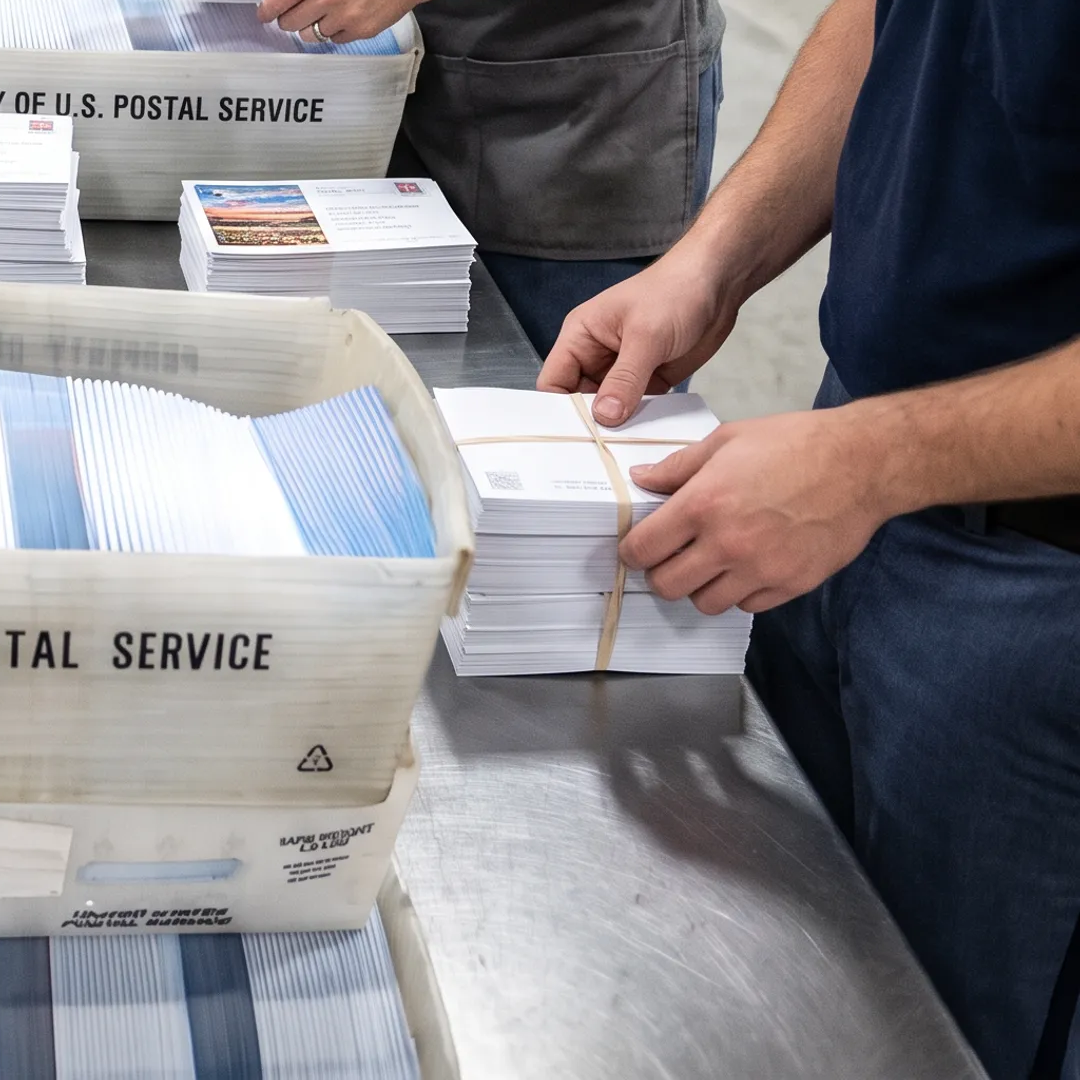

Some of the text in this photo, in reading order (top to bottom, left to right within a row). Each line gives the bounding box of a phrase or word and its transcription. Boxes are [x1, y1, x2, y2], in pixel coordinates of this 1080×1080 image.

[14, 91, 46, 115] OF
[55, 92, 104, 118] U.S.
[113, 94, 209, 121] POSTAL
[218, 96, 324, 123] SERVICE
[112, 631, 273, 671] SERVICE
